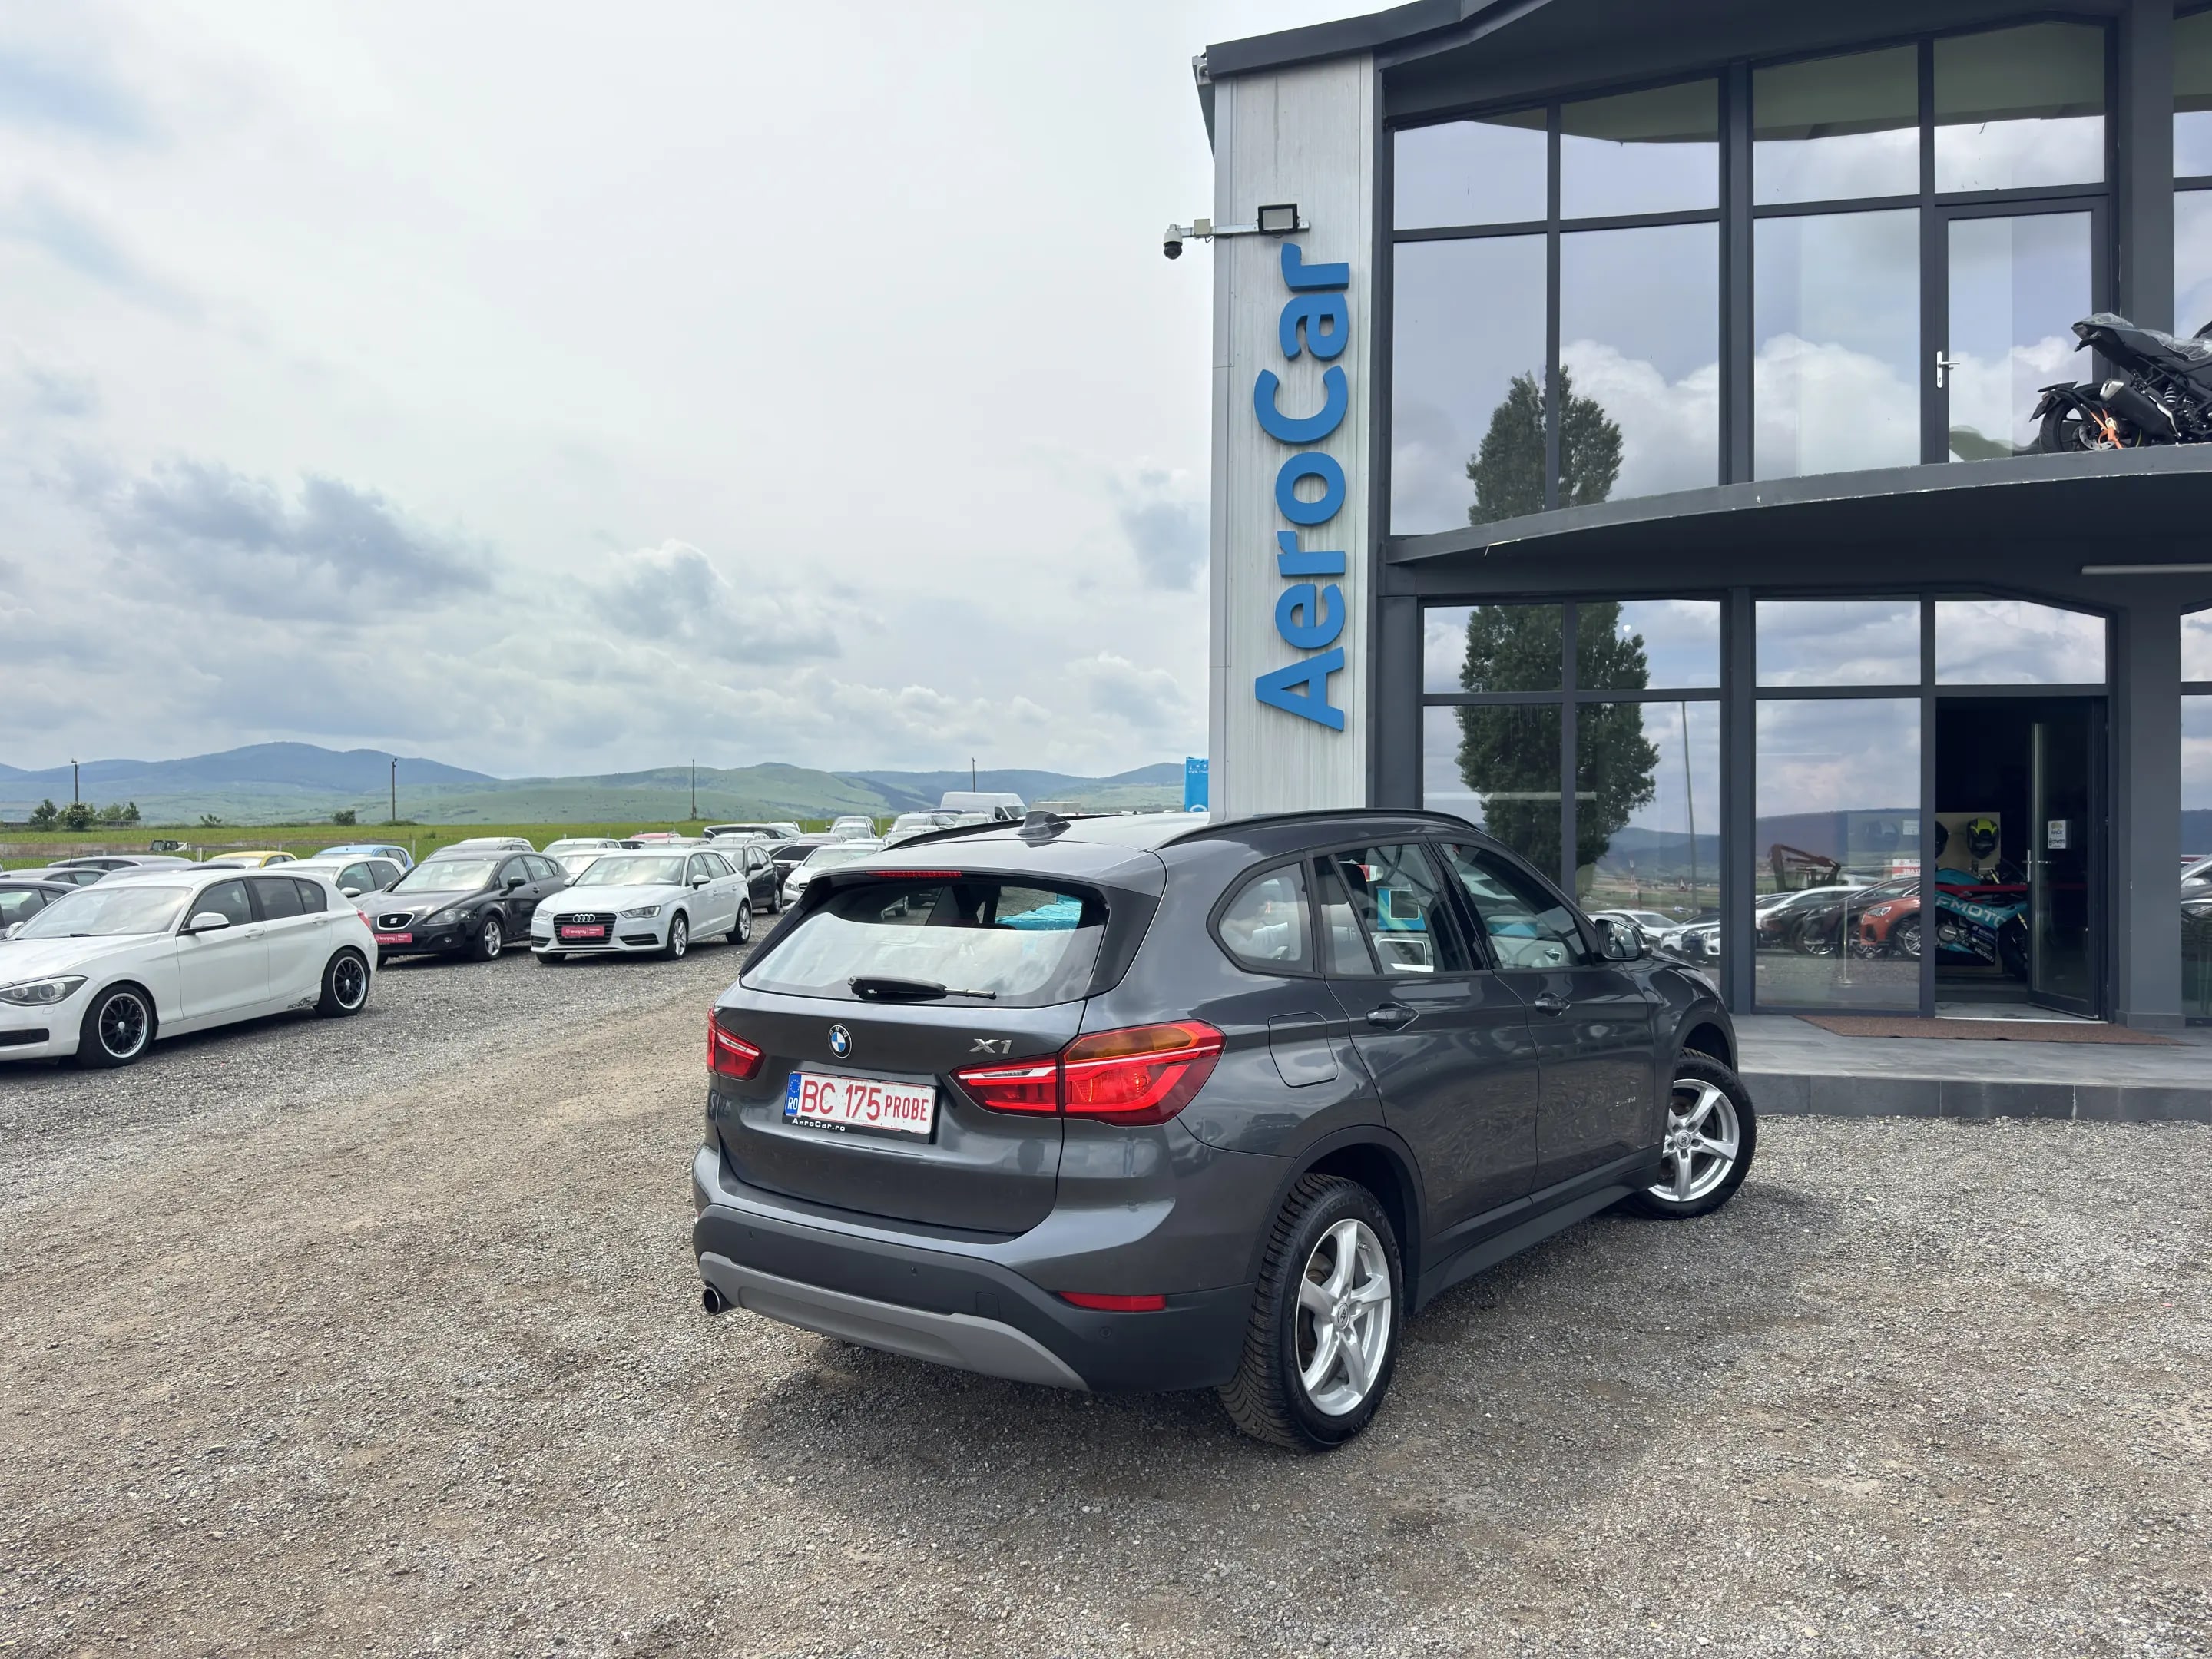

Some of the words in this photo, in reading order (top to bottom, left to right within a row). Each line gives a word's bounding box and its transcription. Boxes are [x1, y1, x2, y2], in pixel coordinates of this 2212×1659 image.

[1254, 243, 1349, 731] AeroCar
[1936, 894, 2008, 929] FMOTO
[968, 1038, 1012, 1054] X1
[787, 1097, 799, 1111] RO
[801, 1080, 836, 1114] BC
[846, 1084, 882, 1121] 175
[885, 1094, 929, 1121] PROBE
[792, 1118, 846, 1131] AeroCar.ro
